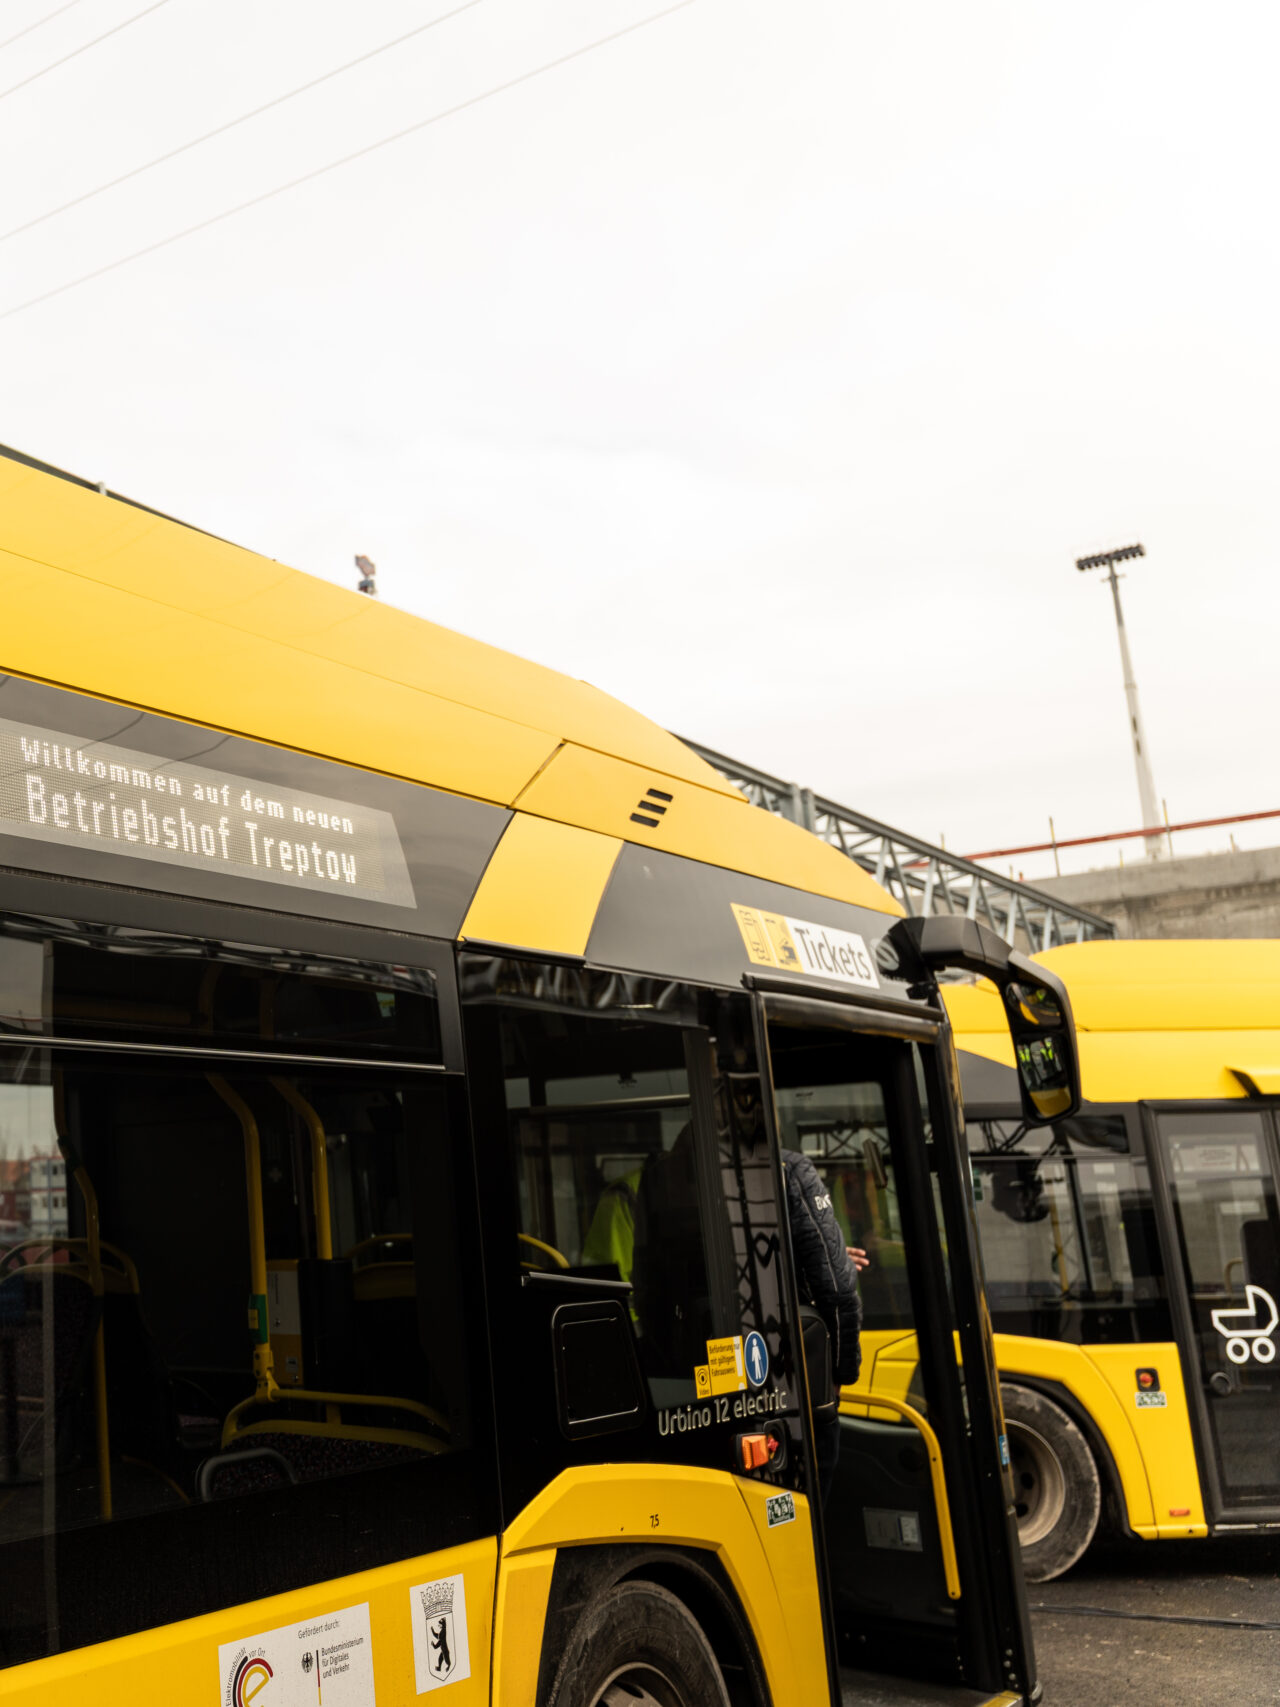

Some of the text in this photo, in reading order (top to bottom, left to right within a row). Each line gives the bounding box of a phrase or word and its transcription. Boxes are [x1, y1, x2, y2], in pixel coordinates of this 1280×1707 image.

[21, 737, 354, 835] Willkommen auf dem neuen
[26, 772, 357, 884] Betriebshof Treptow
[794, 926, 872, 981] Tickets
[658, 1386, 788, 1436] Urbino 12 electric
[297, 1625, 323, 1640] Gefördert
[321, 1636, 364, 1656] Bundesministerium
[322, 1663, 350, 1679] und Verkehr
[329, 1651, 350, 1667] Digitales
